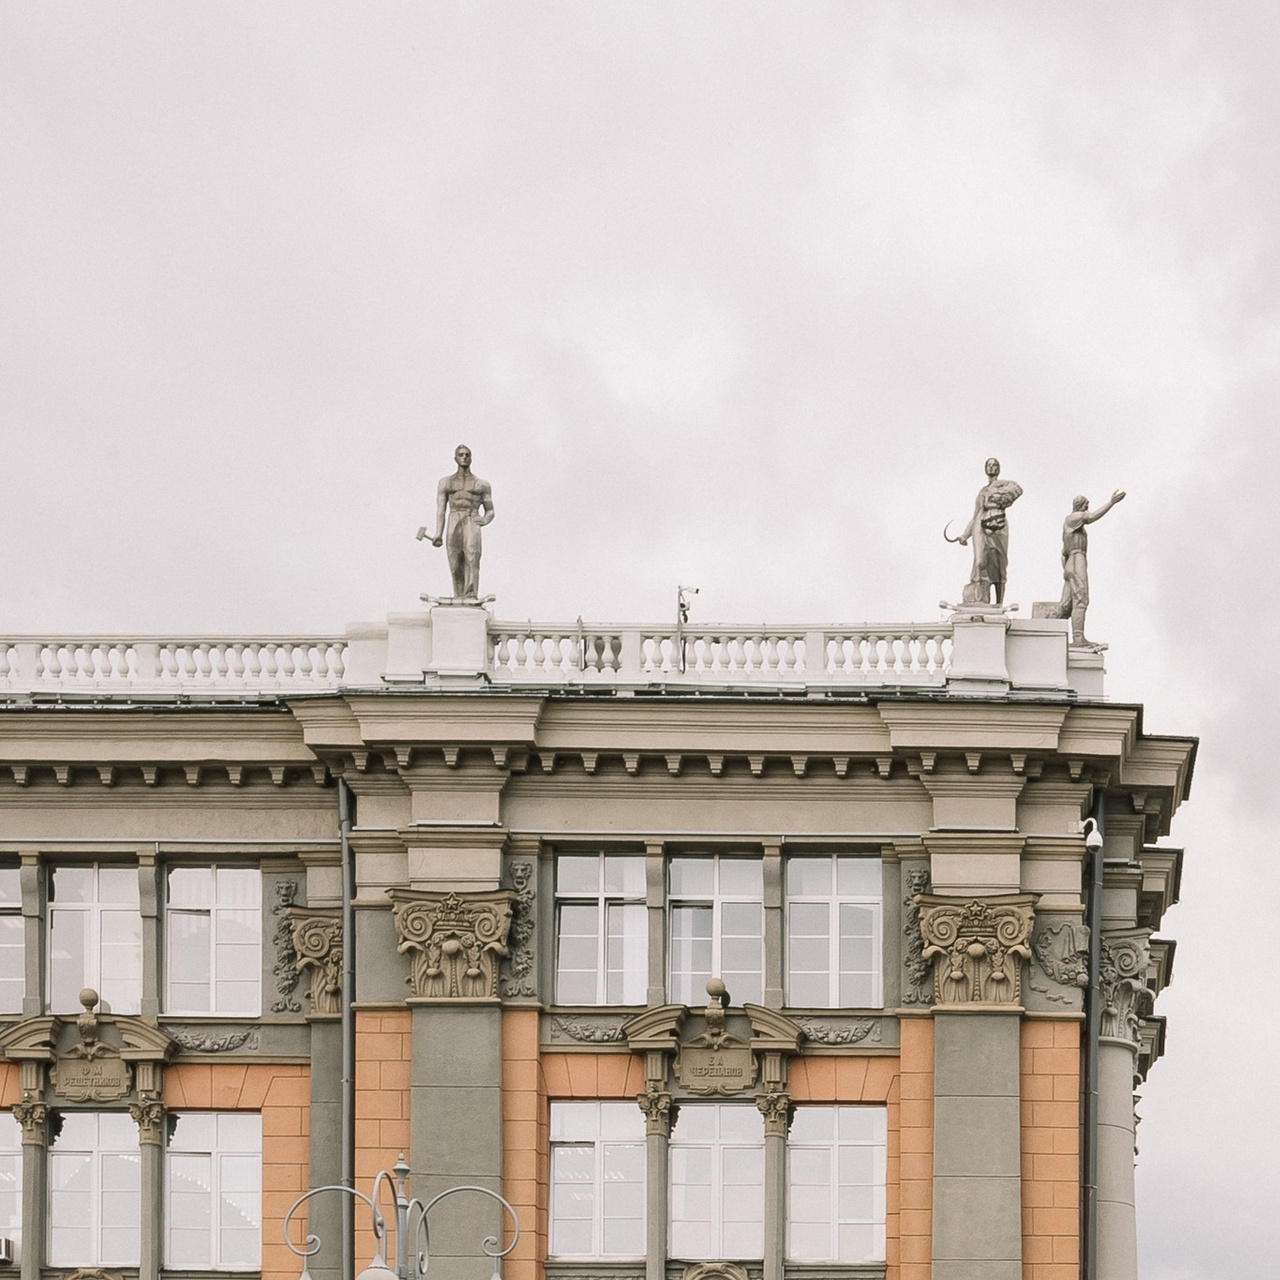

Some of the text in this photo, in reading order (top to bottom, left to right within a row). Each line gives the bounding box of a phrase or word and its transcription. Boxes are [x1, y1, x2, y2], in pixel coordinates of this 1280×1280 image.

[93, 1065, 103, 1076] М
[690, 1067, 743, 1077] ЧЕРЕПАНОВ
[64, 1077, 121, 1087] РЕШЕТНИКОВ
